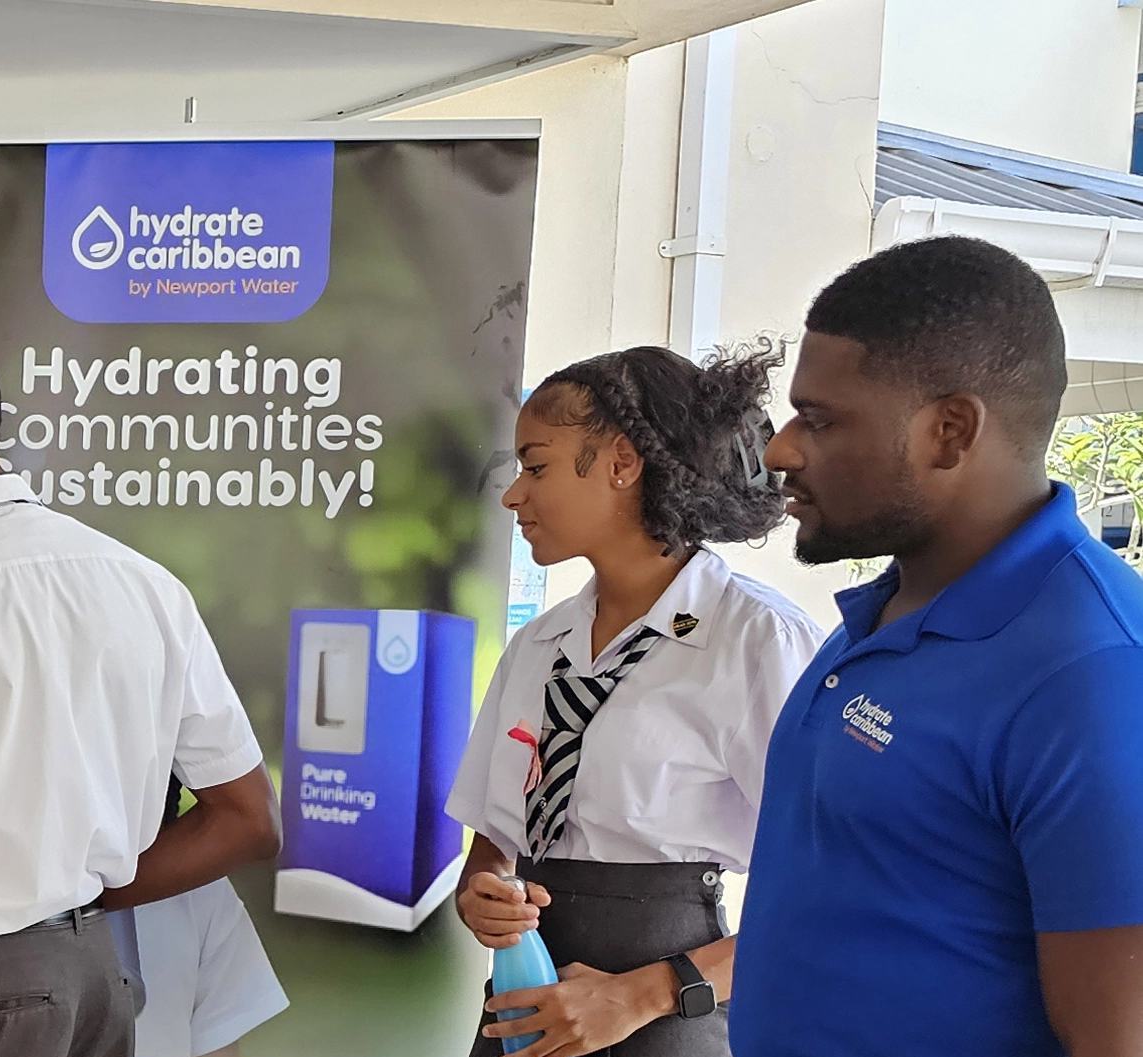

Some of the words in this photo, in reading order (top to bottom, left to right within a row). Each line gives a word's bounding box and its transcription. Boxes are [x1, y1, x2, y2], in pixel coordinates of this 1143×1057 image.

[130, 205, 264, 245] hydrate
[127, 238, 300, 270] caribbean
[128, 279, 152, 298] by
[156, 279, 236, 297] Newport
[241, 279, 299, 294] Water
[21, 345, 342, 408] Hydrating
[859, 697, 893, 726] hydrate
[849, 713, 894, 745] caribbean
[302, 763, 347, 784] Pure
[300, 781, 376, 810] Drinking
[301, 802, 361, 825] Water
